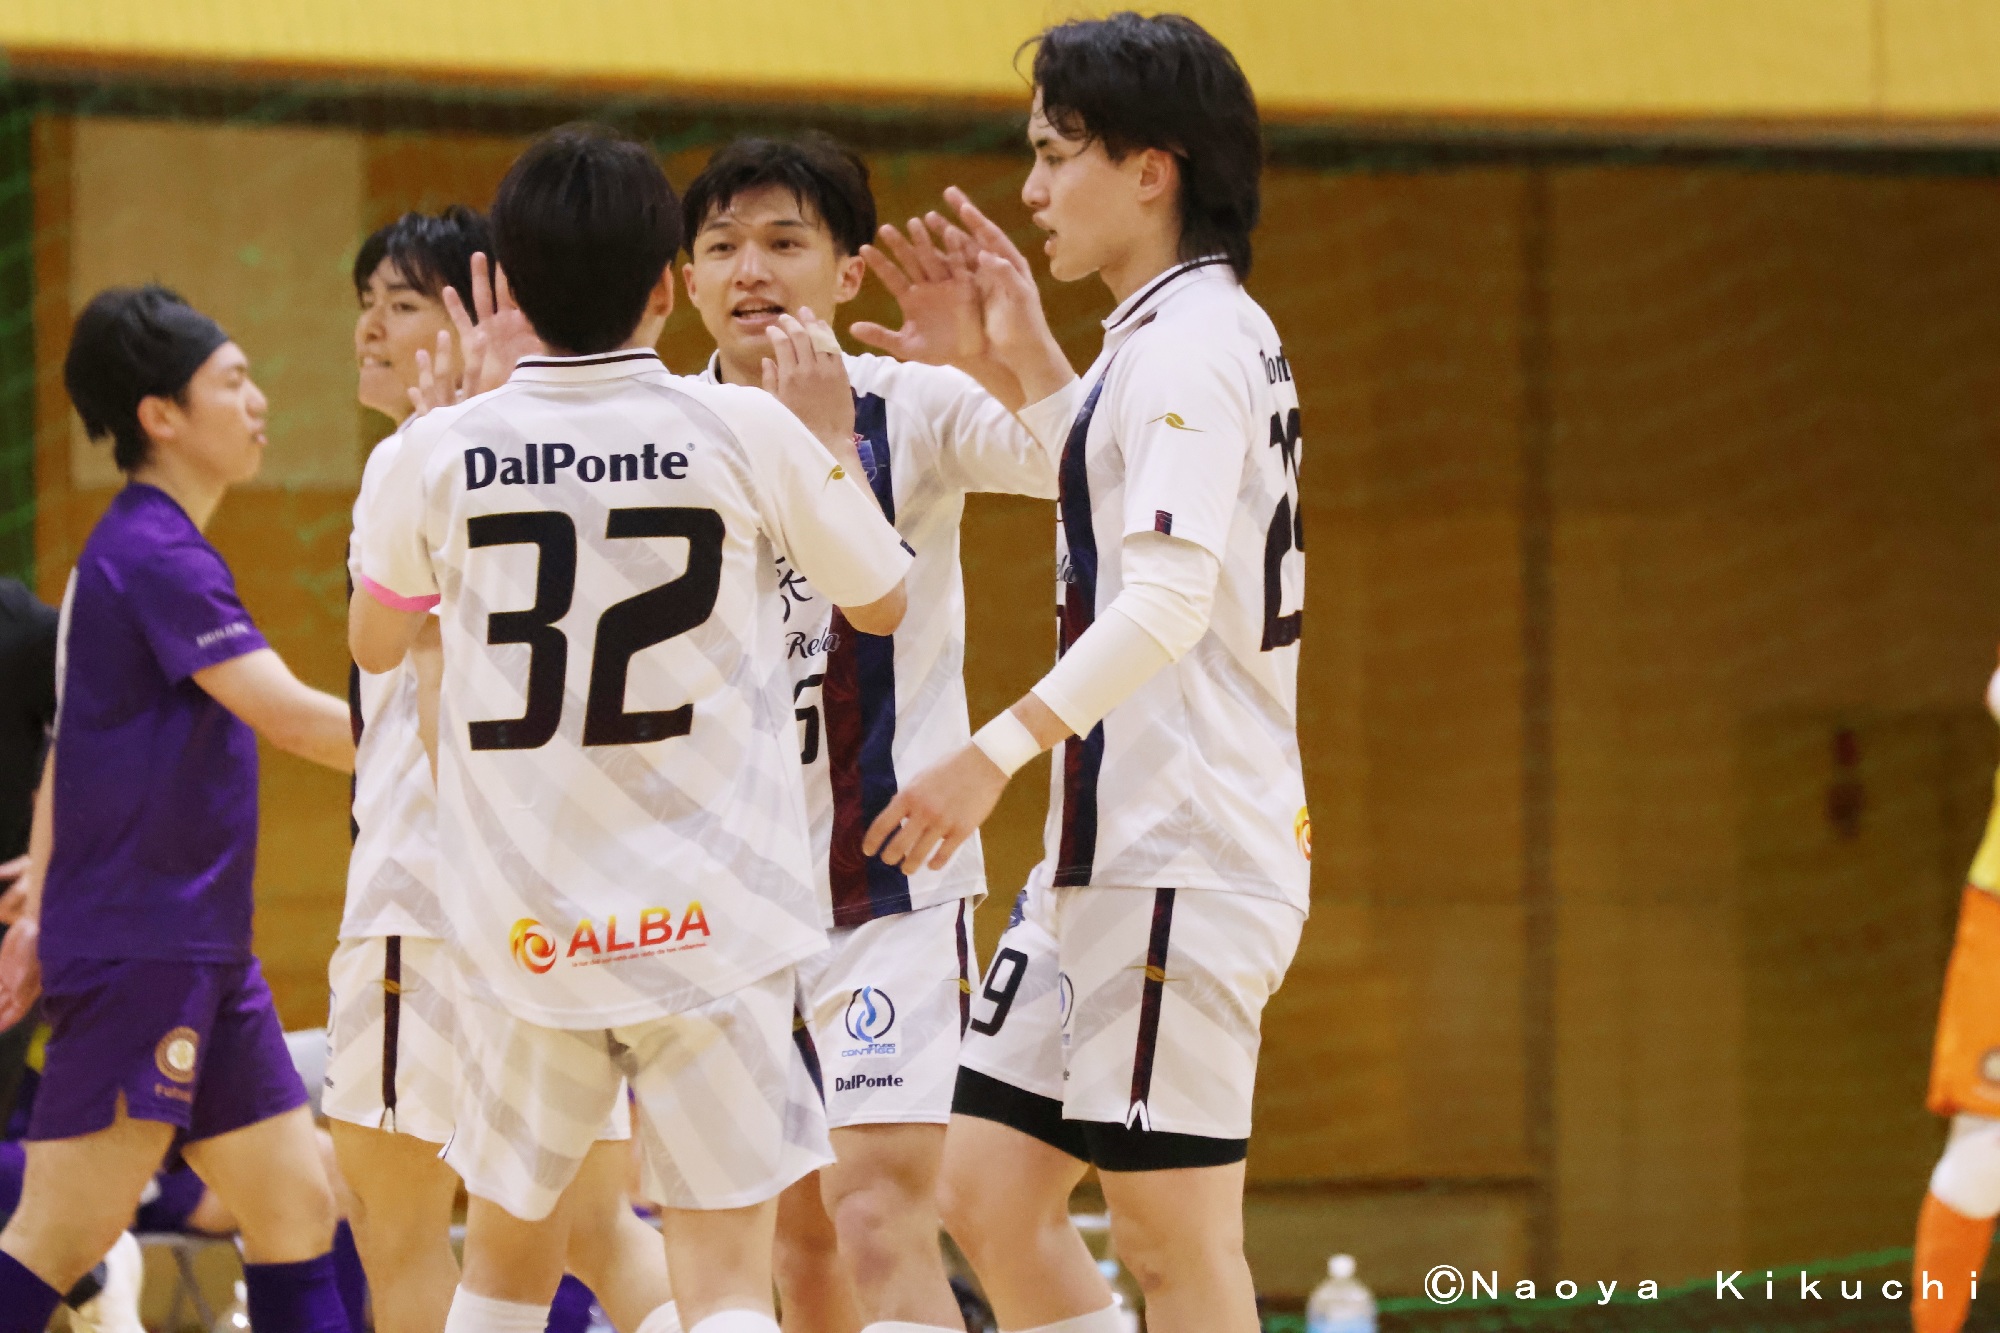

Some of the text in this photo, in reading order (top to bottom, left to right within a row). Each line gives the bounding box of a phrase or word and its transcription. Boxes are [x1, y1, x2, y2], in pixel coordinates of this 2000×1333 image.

[467, 507, 726, 752] 32
[566, 899, 711, 958] ALBA
[970, 947, 1028, 1037] 9
[835, 1074, 904, 1092] DalPonte
